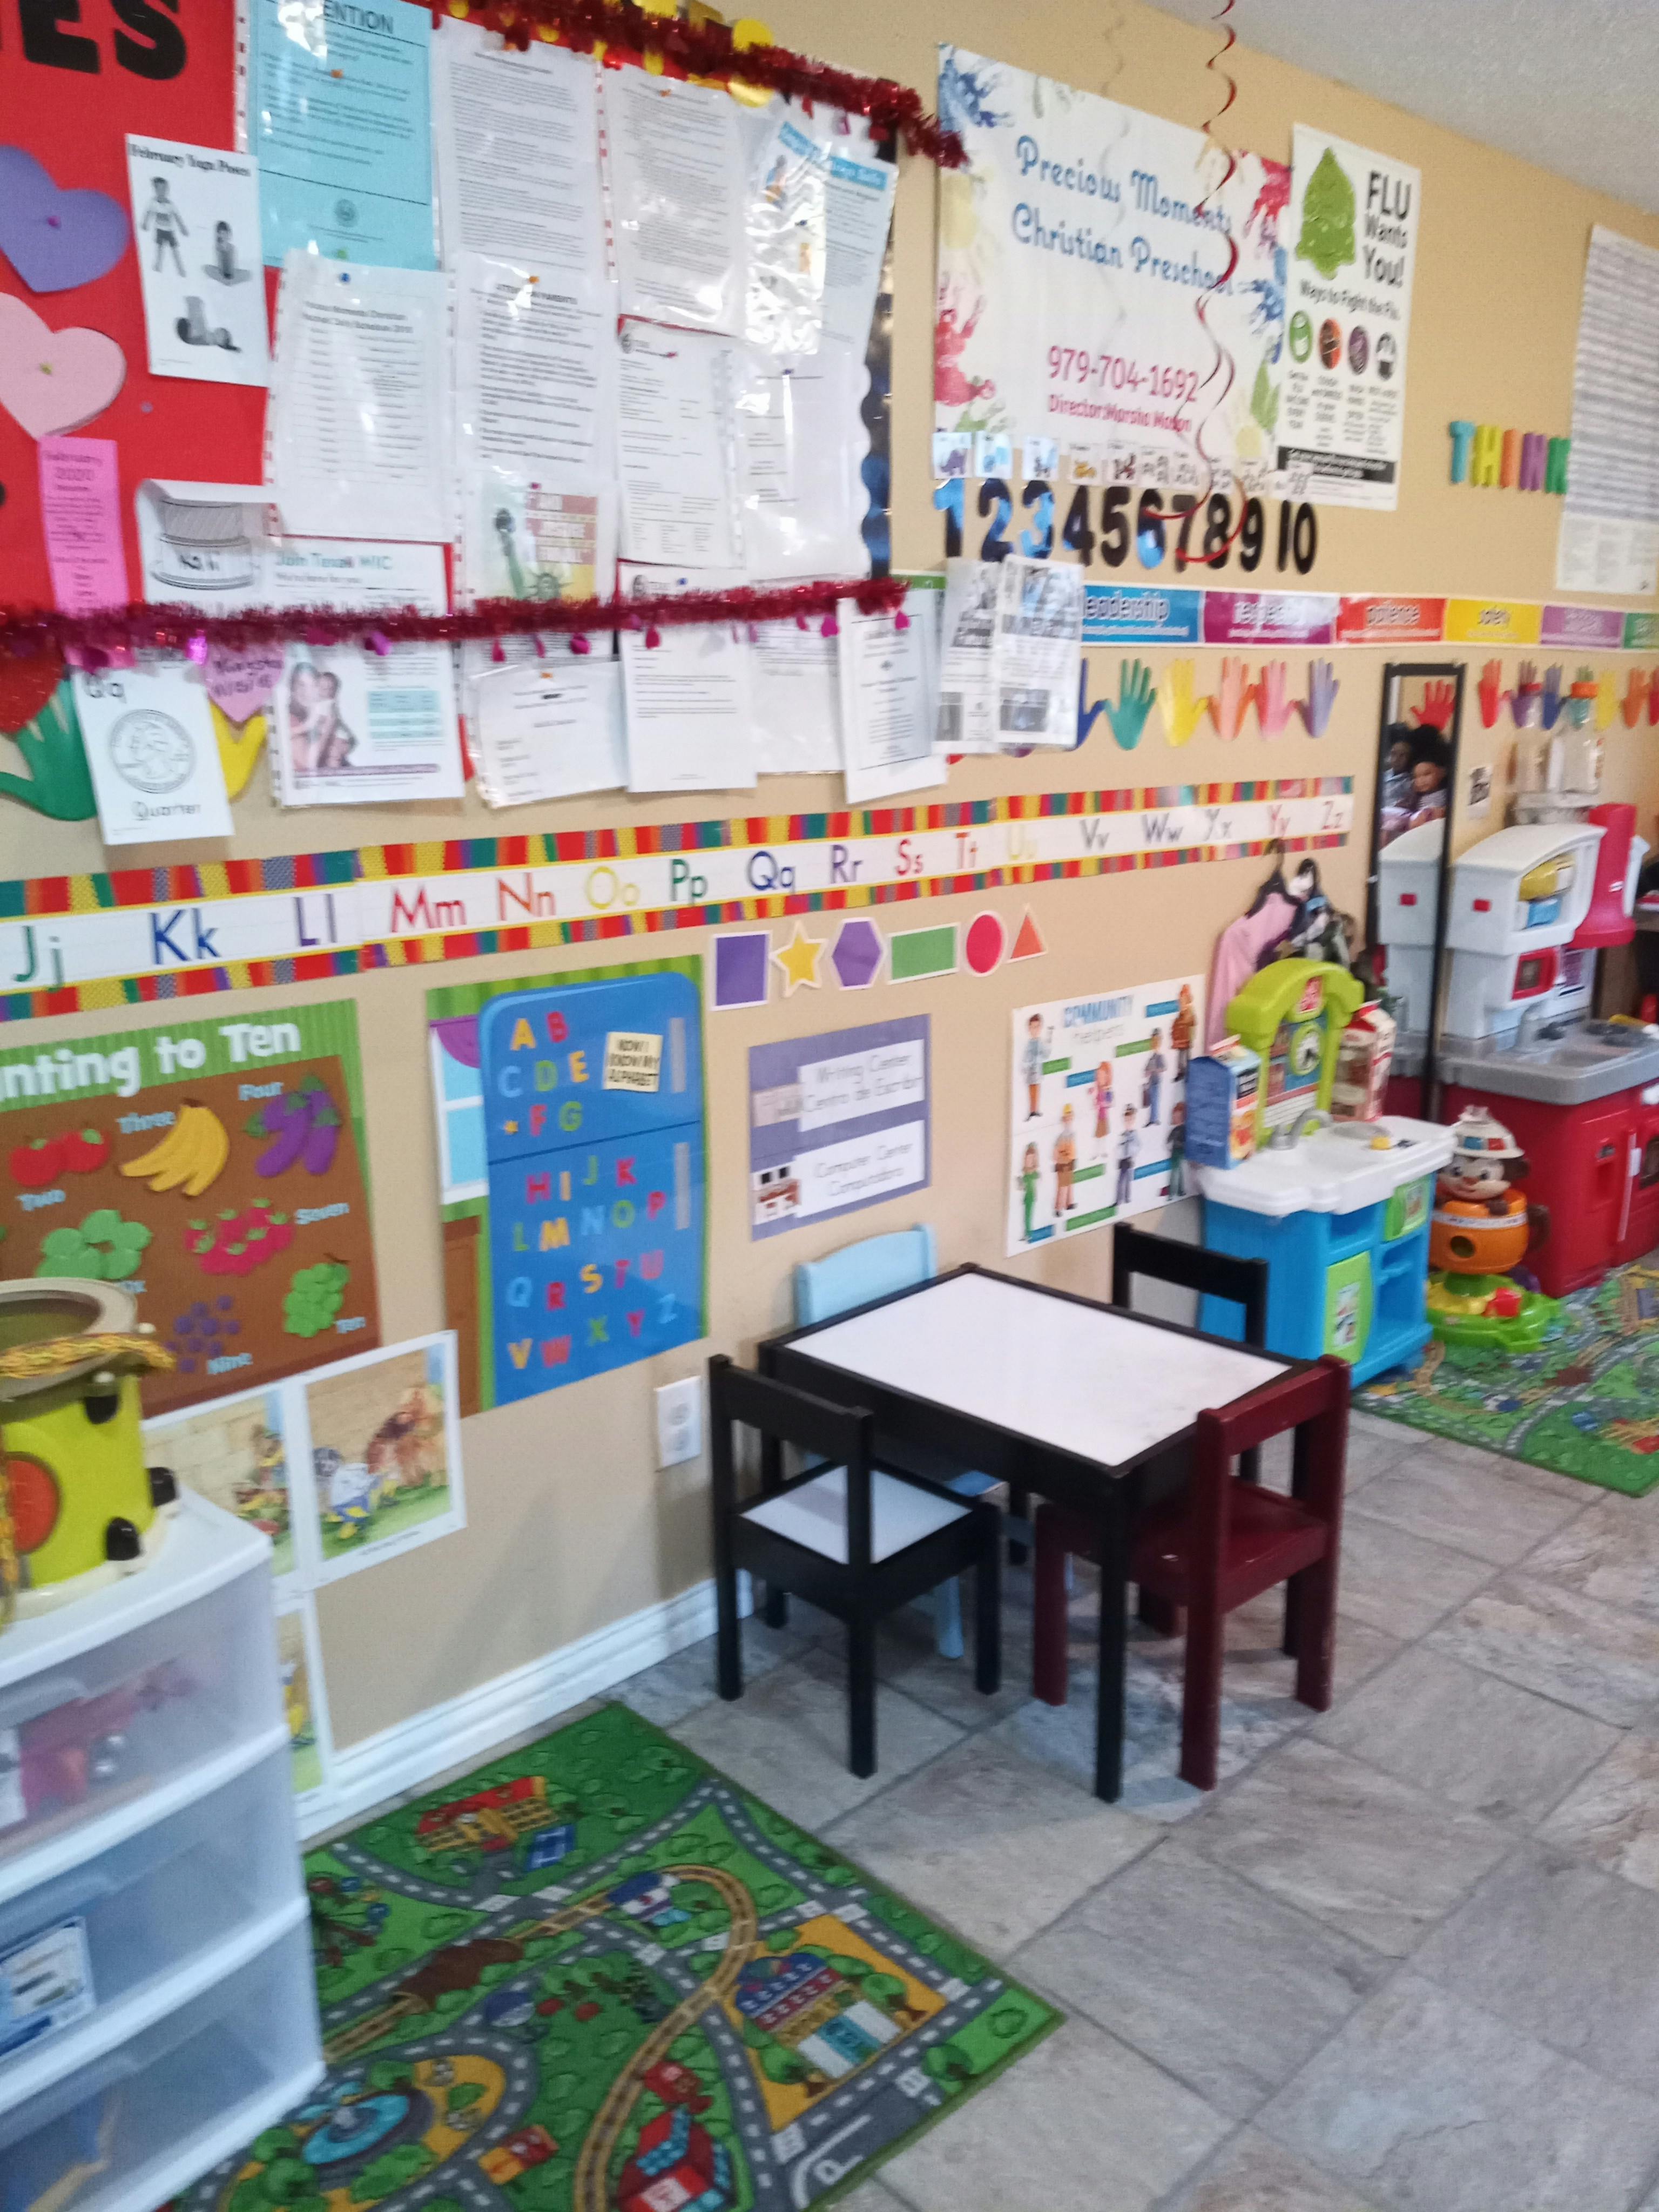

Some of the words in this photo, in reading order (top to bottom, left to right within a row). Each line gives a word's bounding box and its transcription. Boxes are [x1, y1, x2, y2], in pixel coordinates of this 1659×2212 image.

[0, 0, 186, 80] ES
[1016, 135, 1122, 203] Precious
[1130, 169, 1232, 235] Moments
[1366, 170, 1412, 221] FLU
[1012, 203, 1124, 269] Christian
[1048, 345, 1199, 402] 979-704-1692
[1447, 420, 1571, 496] THINK
[934, 477, 964, 558] 1
[979, 478, 1013, 562] 2
[1021, 479, 1055, 559] 3
[1063, 484, 1095, 567] 4
[1101, 485, 1131, 568] 5
[1137, 488, 1165, 569] 6
[1172, 494, 1198, 572] 7
[1204, 494, 1231, 569] 8
[1239, 497, 1265, 572] 9
[1277, 499, 1318, 575] 10
[1081, 589, 1170, 626] eadership
[14, 925, 65, 992] Jj
[149, 908, 221, 966] Kk
[391, 884, 467, 933] Mm
[497, 872, 557, 921] Nn
[584, 865, 640, 910] Oo
[669, 858, 709, 906] Pp
[746, 850, 796, 894] Qq
[829, 844, 863, 884] Rr
[894, 838, 925, 876] Ss
[955, 832, 979, 870] Tt
[1080, 818, 1110, 851] Vv
[1142, 812, 1183, 844] Ww
[1320, 800, 1344, 831] Zz
[510, 1018, 537, 1051] A
[546, 1010, 570, 1043] B
[1063, 994, 1134, 1028] COMMUNITY
[0, 1047, 141, 1098] nting
[154, 1036, 207, 1074] to
[219, 1023, 301, 1062] Ten
[498, 1065, 523, 1098] C
[534, 1060, 558, 1092] D
[569, 1050, 590, 1083] E
[529, 1104, 548, 1137] F
[558, 1100, 584, 1132] G
[525, 1171, 551, 1205] H
[559, 1170, 571, 1202] I
[583, 1155, 599, 1186] J
[616, 1156, 638, 1187] K
[513, 1222, 530, 1252] L
[539, 1217, 571, 1252] M
[580, 1204, 605, 1236] N
[611, 1199, 636, 1229] O
[647, 1190, 666, 1221] P
[507, 1276, 533, 1309] Q
[545, 1282, 567, 1312] R
[579, 1263, 604, 1294] S
[615, 1259, 631, 1289] T
[640, 1249, 664, 1280] U
[507, 1338, 533, 1370] V
[541, 1334, 572, 1368] W
[588, 1314, 610, 1346] X
[626, 1309, 646, 1338] Y
[657, 1293, 678, 1324] Z
